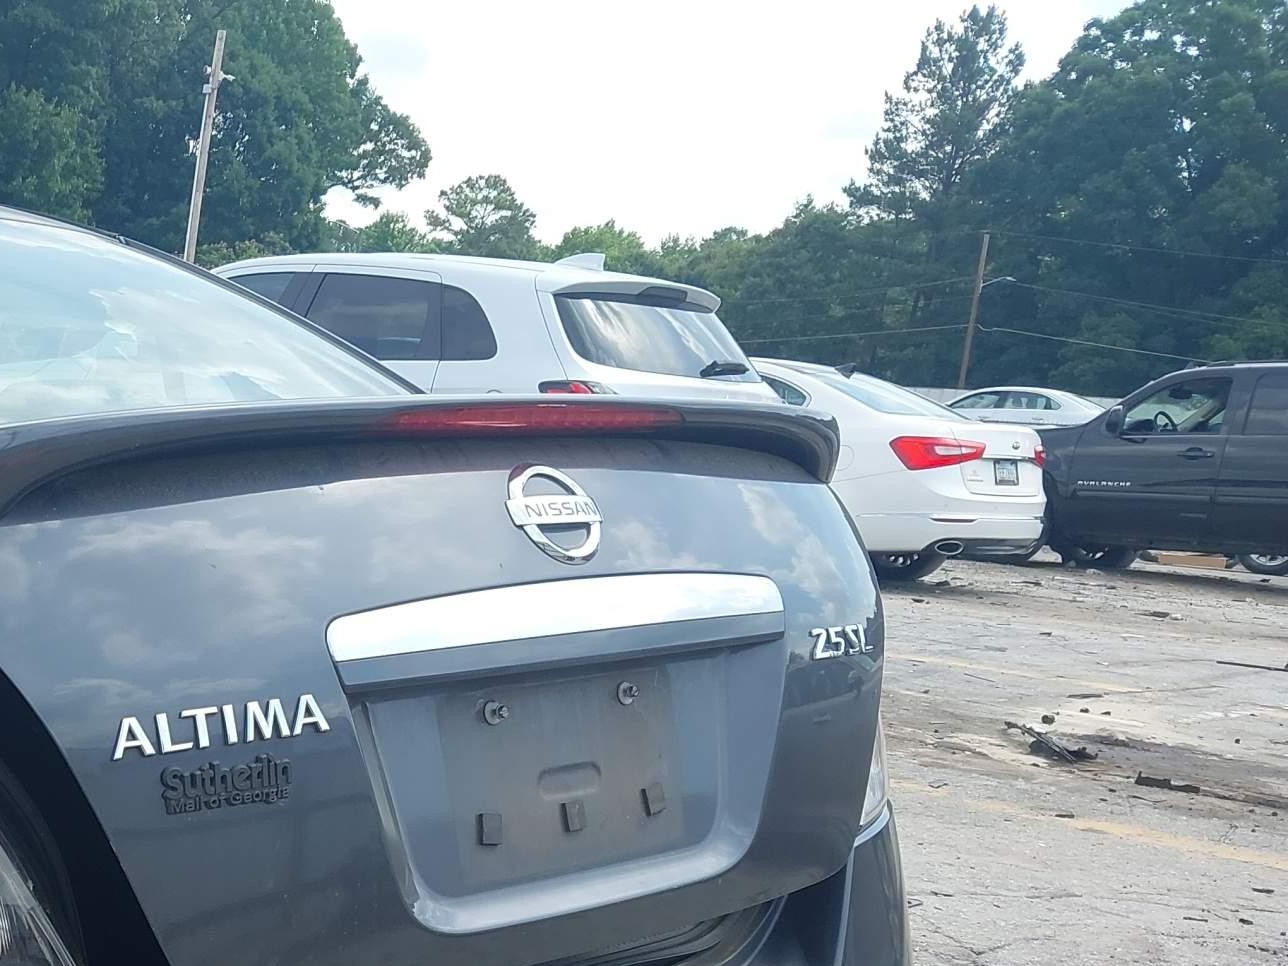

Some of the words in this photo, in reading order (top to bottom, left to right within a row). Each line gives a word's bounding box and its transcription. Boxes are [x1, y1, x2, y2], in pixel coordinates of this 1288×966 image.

[1077, 479, 1132, 488] AVALANCHE
[524, 501, 598, 518] NISSAN
[113, 694, 330, 760] ALTIMA
[161, 753, 294, 800] Sutherlin
